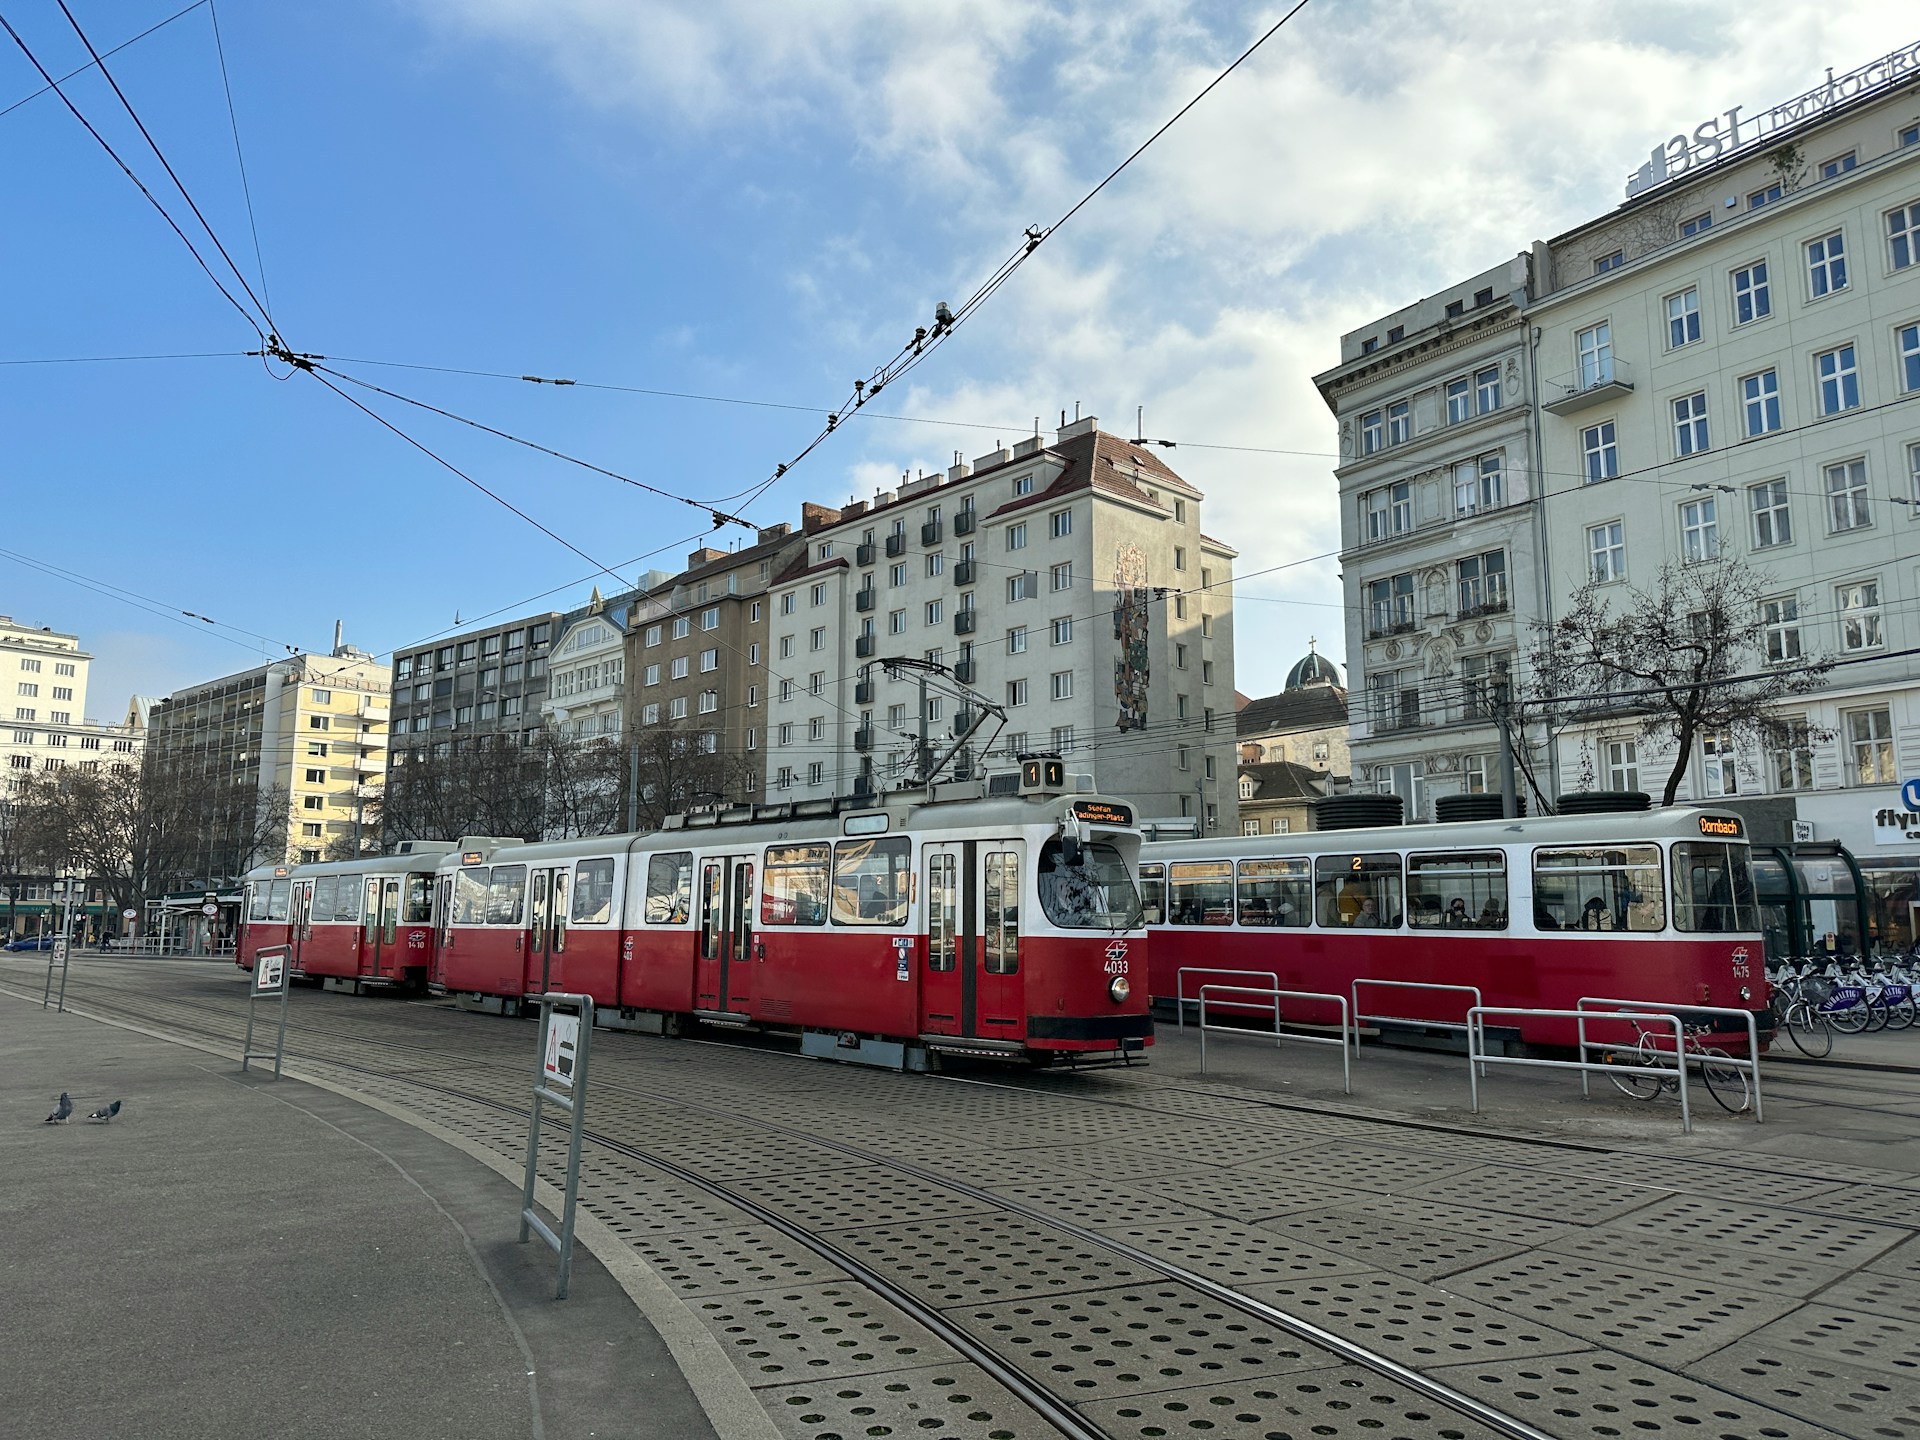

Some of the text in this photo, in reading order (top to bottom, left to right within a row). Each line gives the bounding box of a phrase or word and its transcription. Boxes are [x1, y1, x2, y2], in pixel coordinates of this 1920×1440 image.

[1667, 105, 1743, 178] 3SI
[1030, 766, 1036, 782] 1
[1049, 766, 1056, 781] 1
[1087, 804, 1112, 813] Stefan
[1700, 817, 1738, 834] Dornbach
[1875, 808, 1920, 830] flyi
[1352, 857, 1361, 870] 2
[1103, 960, 1129, 974] 4033
[1732, 965, 1750, 978] 1475
